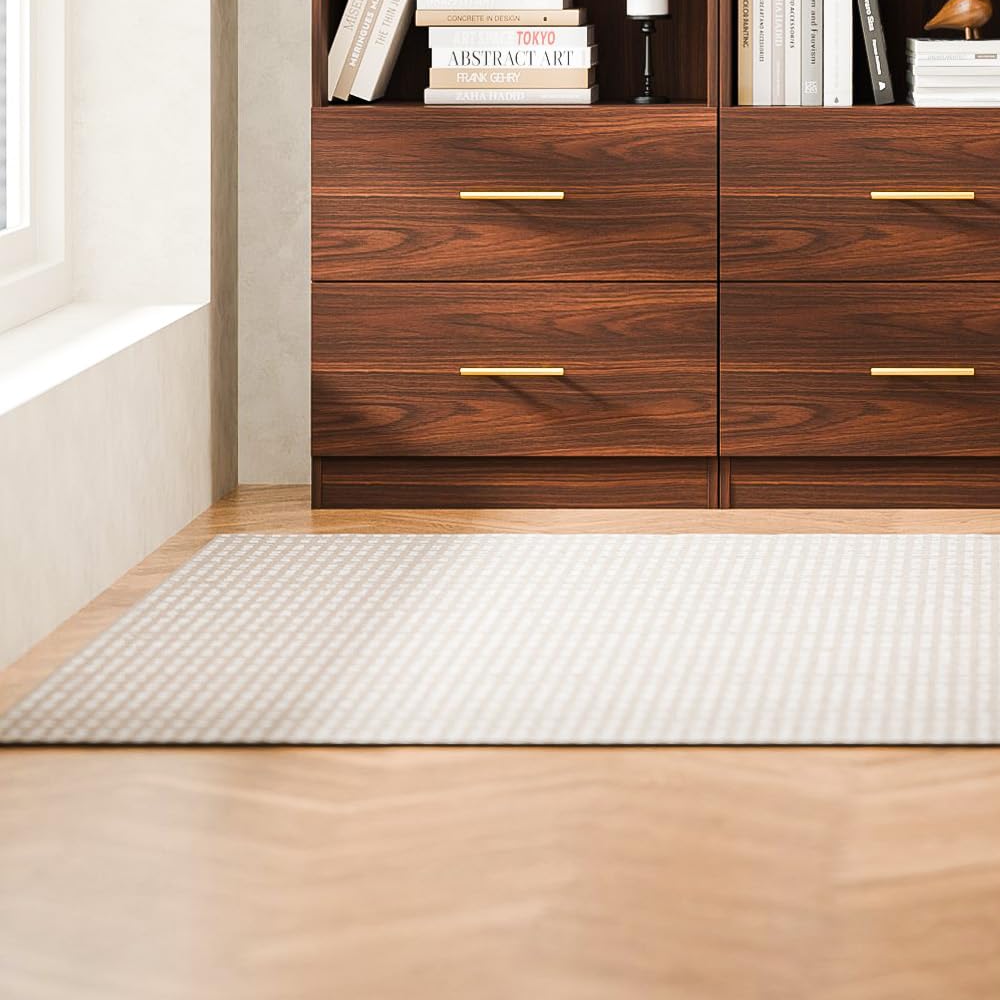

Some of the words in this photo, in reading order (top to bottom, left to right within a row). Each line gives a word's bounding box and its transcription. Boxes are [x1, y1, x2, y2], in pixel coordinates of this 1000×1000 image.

[447, 15, 484, 23] CONCRETE
[494, 15, 521, 23] DESIGN
[349, 12, 375, 67] MERINGUES
[375, 28, 389, 46] THE
[516, 30, 556, 46] TOKYO
[447, 50, 537, 67] ABSTRACT
[538, 50, 575, 67] ART
[456, 72, 488, 83] FRANK
[489, 72, 521, 83] GEHRY
